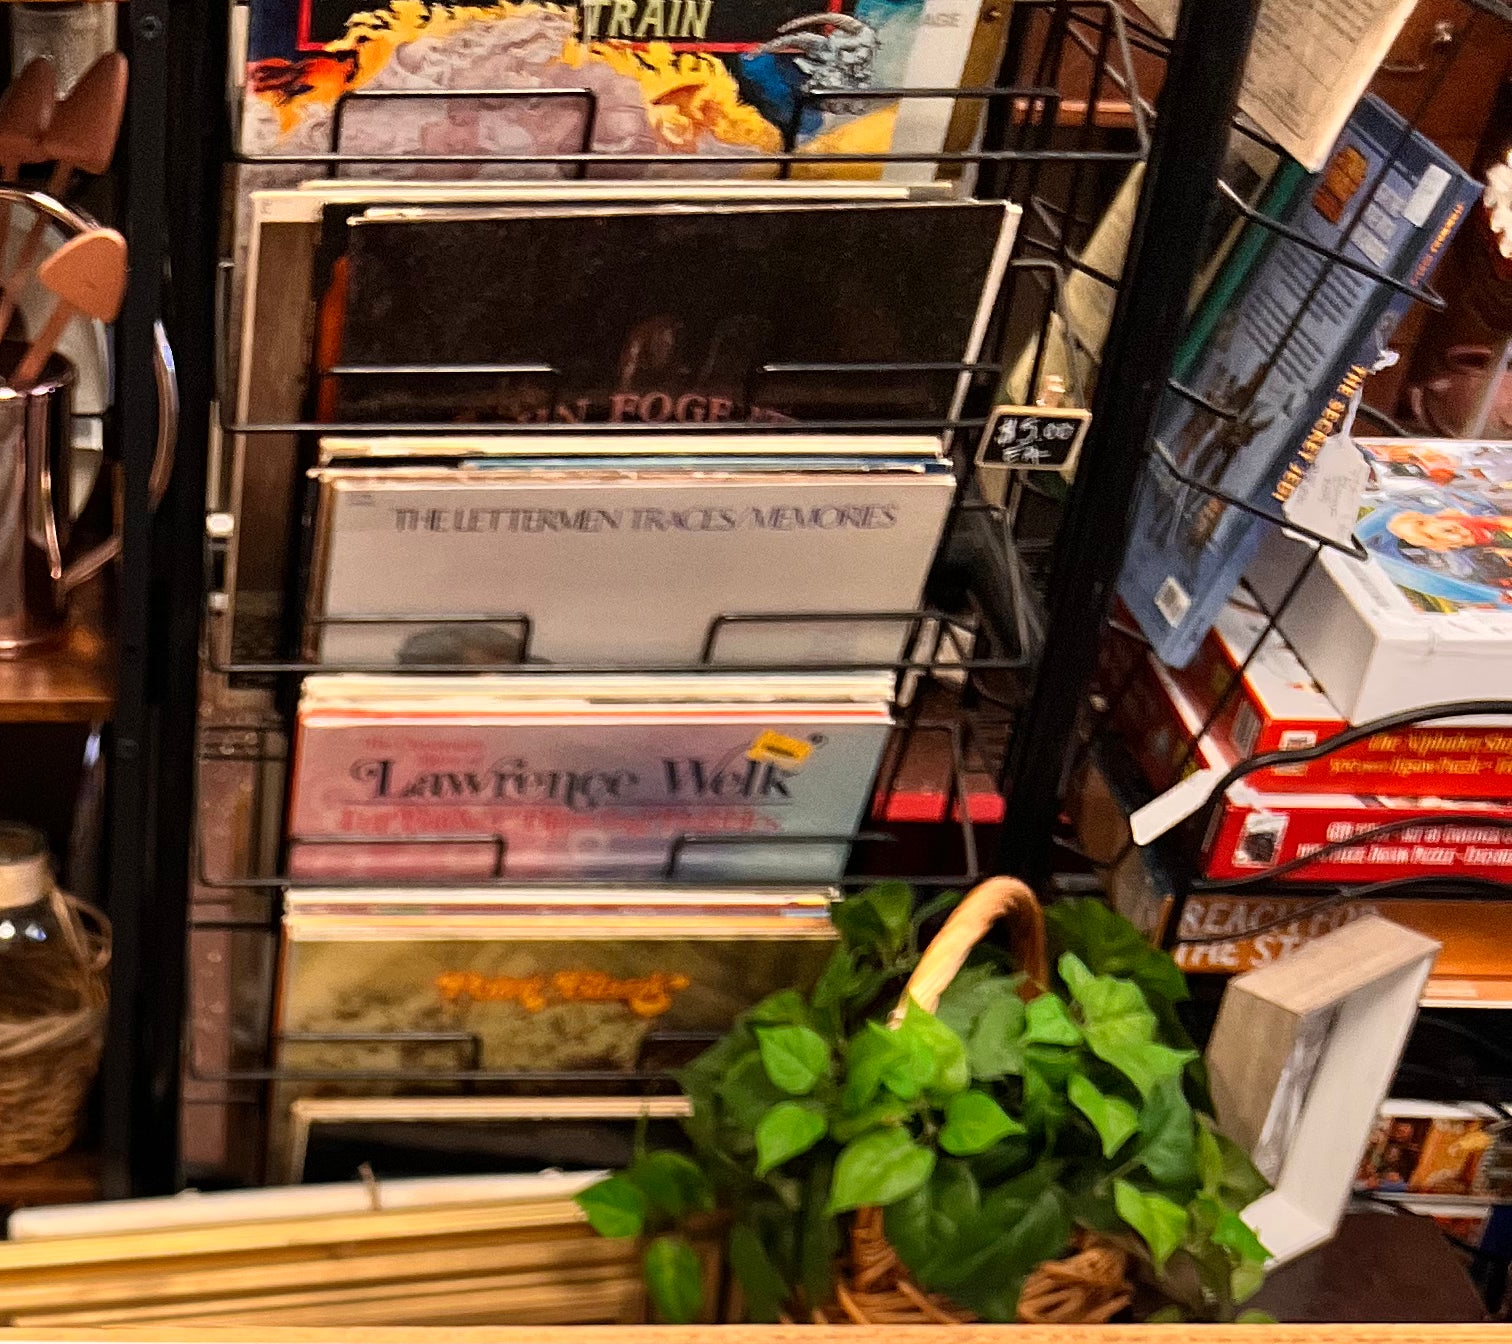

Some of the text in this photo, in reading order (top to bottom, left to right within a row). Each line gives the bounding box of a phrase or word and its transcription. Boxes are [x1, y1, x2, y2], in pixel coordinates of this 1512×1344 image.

[582, 0, 713, 38] TRAIN
[350, 742, 800, 811] Lawrence Welk
